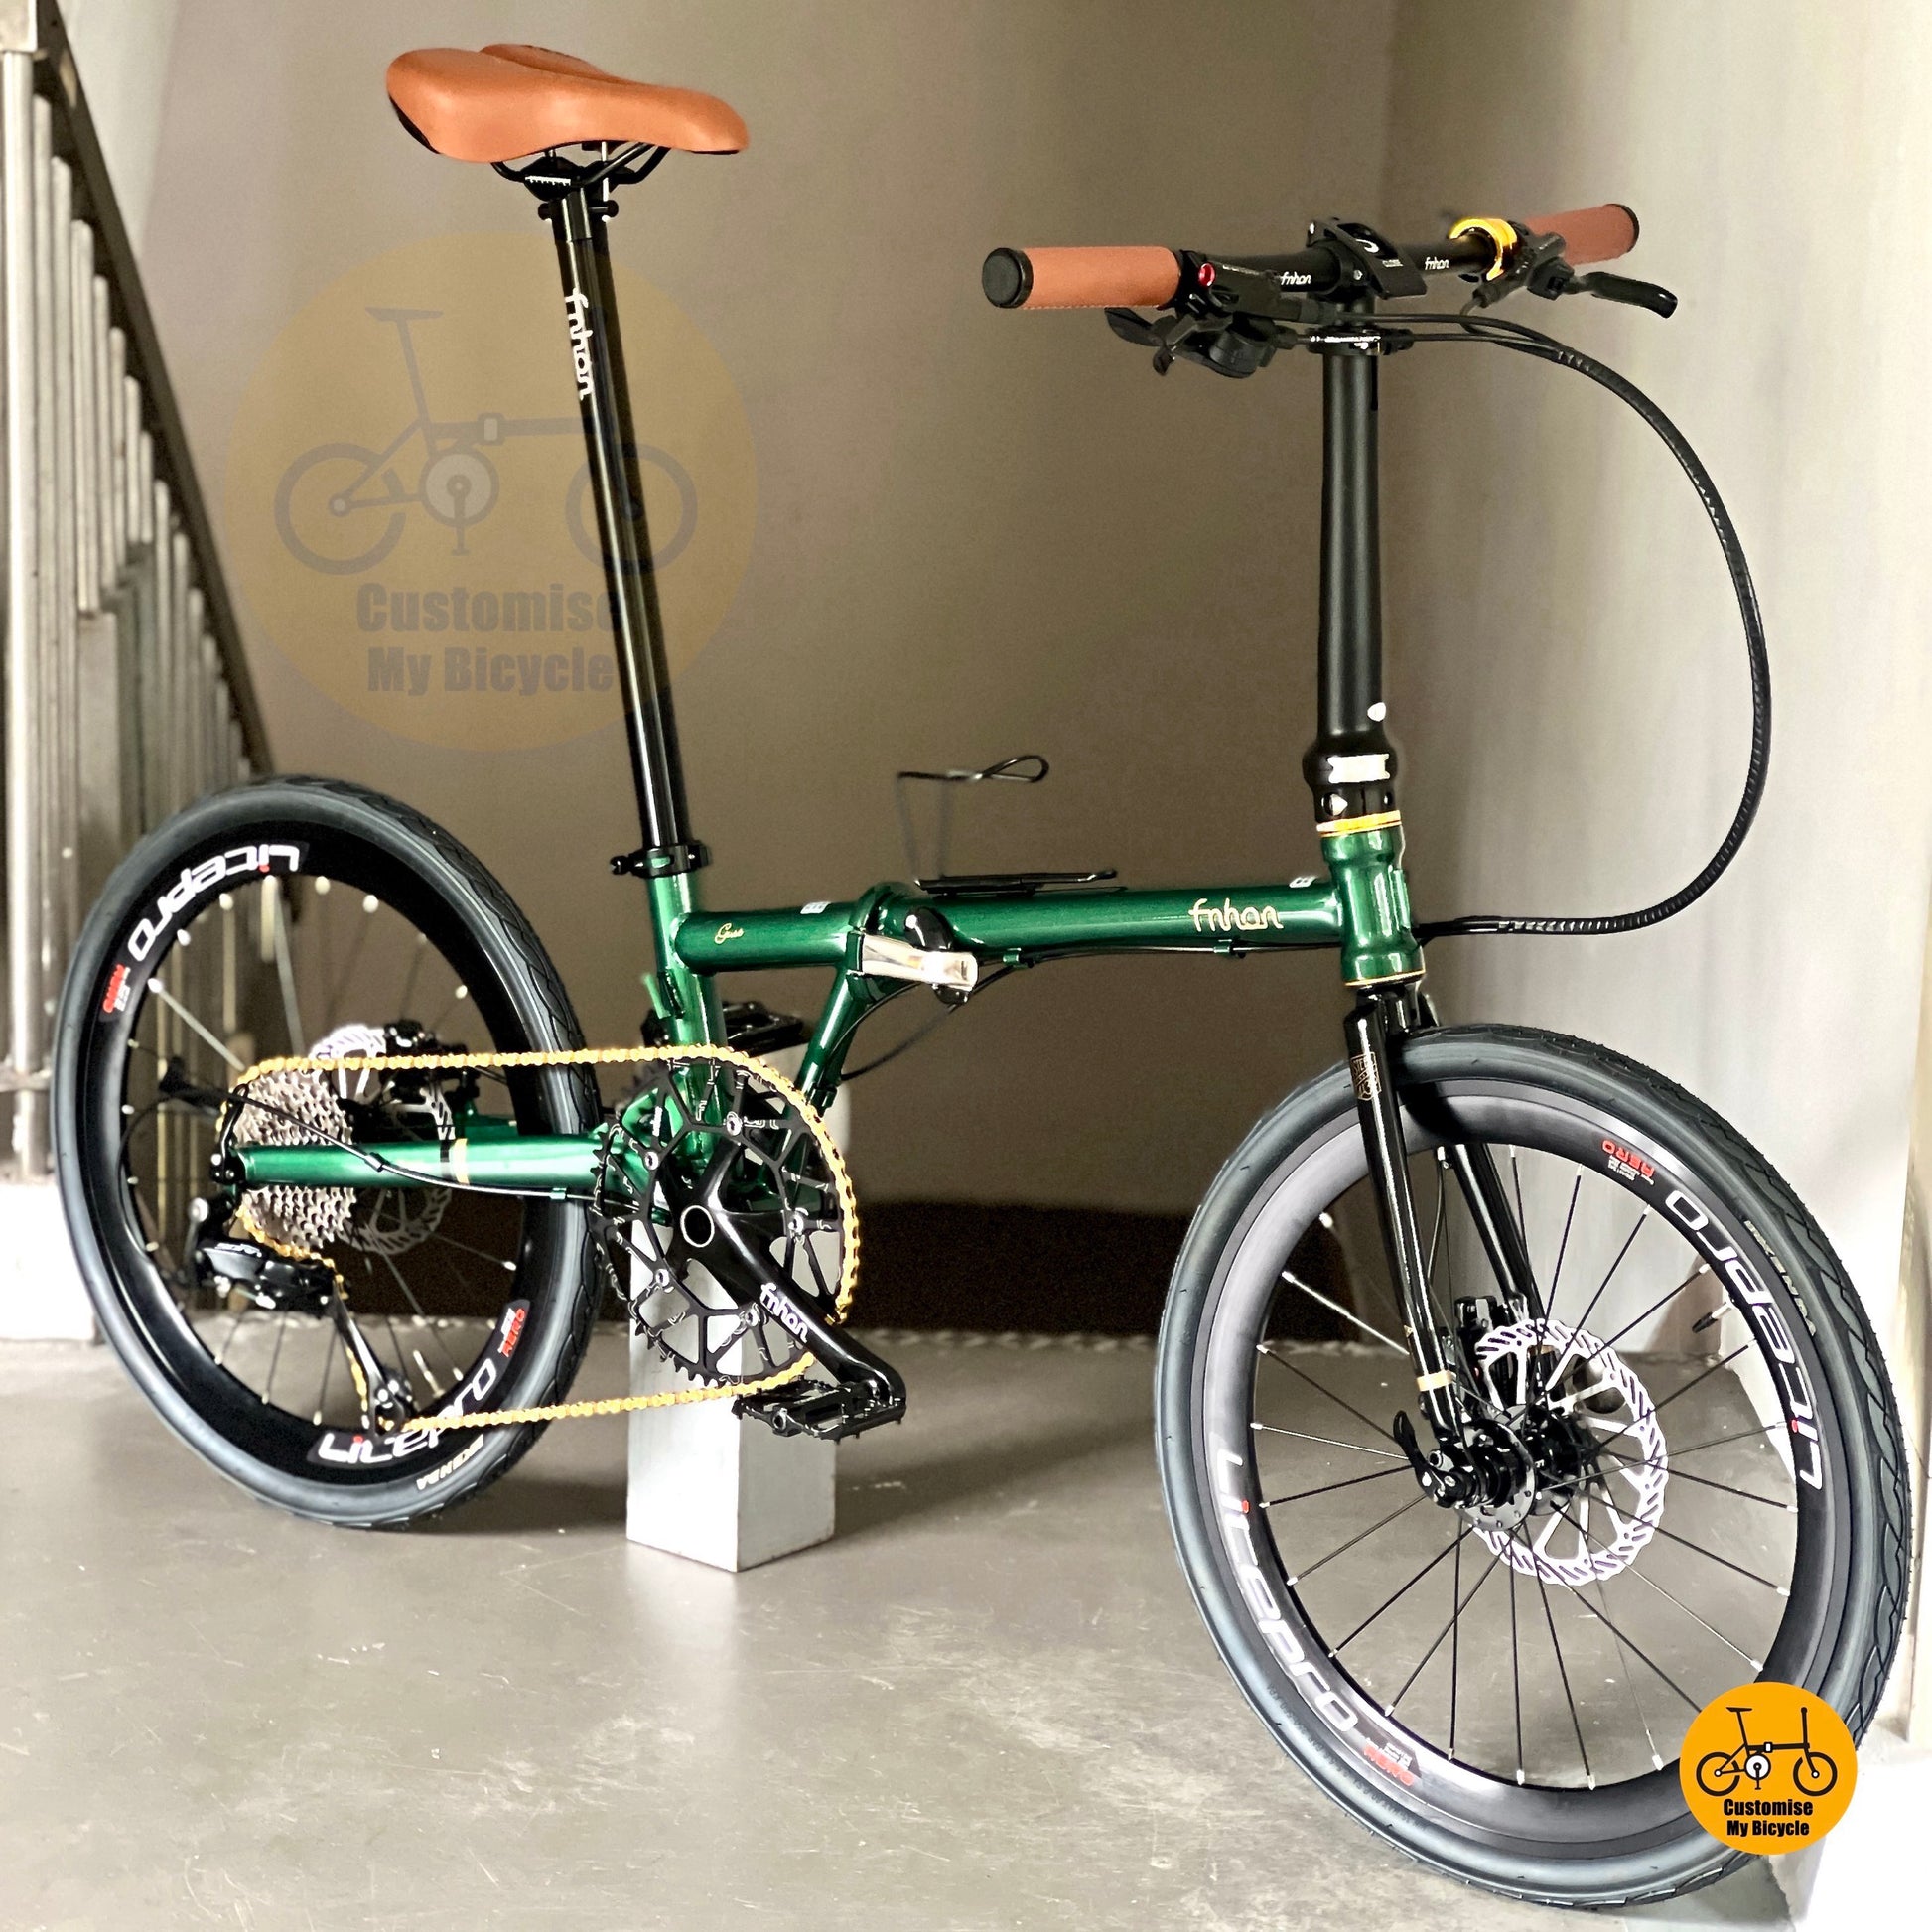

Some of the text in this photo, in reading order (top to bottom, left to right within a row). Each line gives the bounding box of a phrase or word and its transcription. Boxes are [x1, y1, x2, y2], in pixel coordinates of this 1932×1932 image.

[1281, 271, 1311, 285] fnhan
[1425, 256, 1449, 270] fnhan
[565, 287, 593, 401] fnhan
[1188, 897, 1284, 932] fnhan
[1602, 1140, 1655, 1177] AERO
[759, 1282, 808, 1344] fnhan
